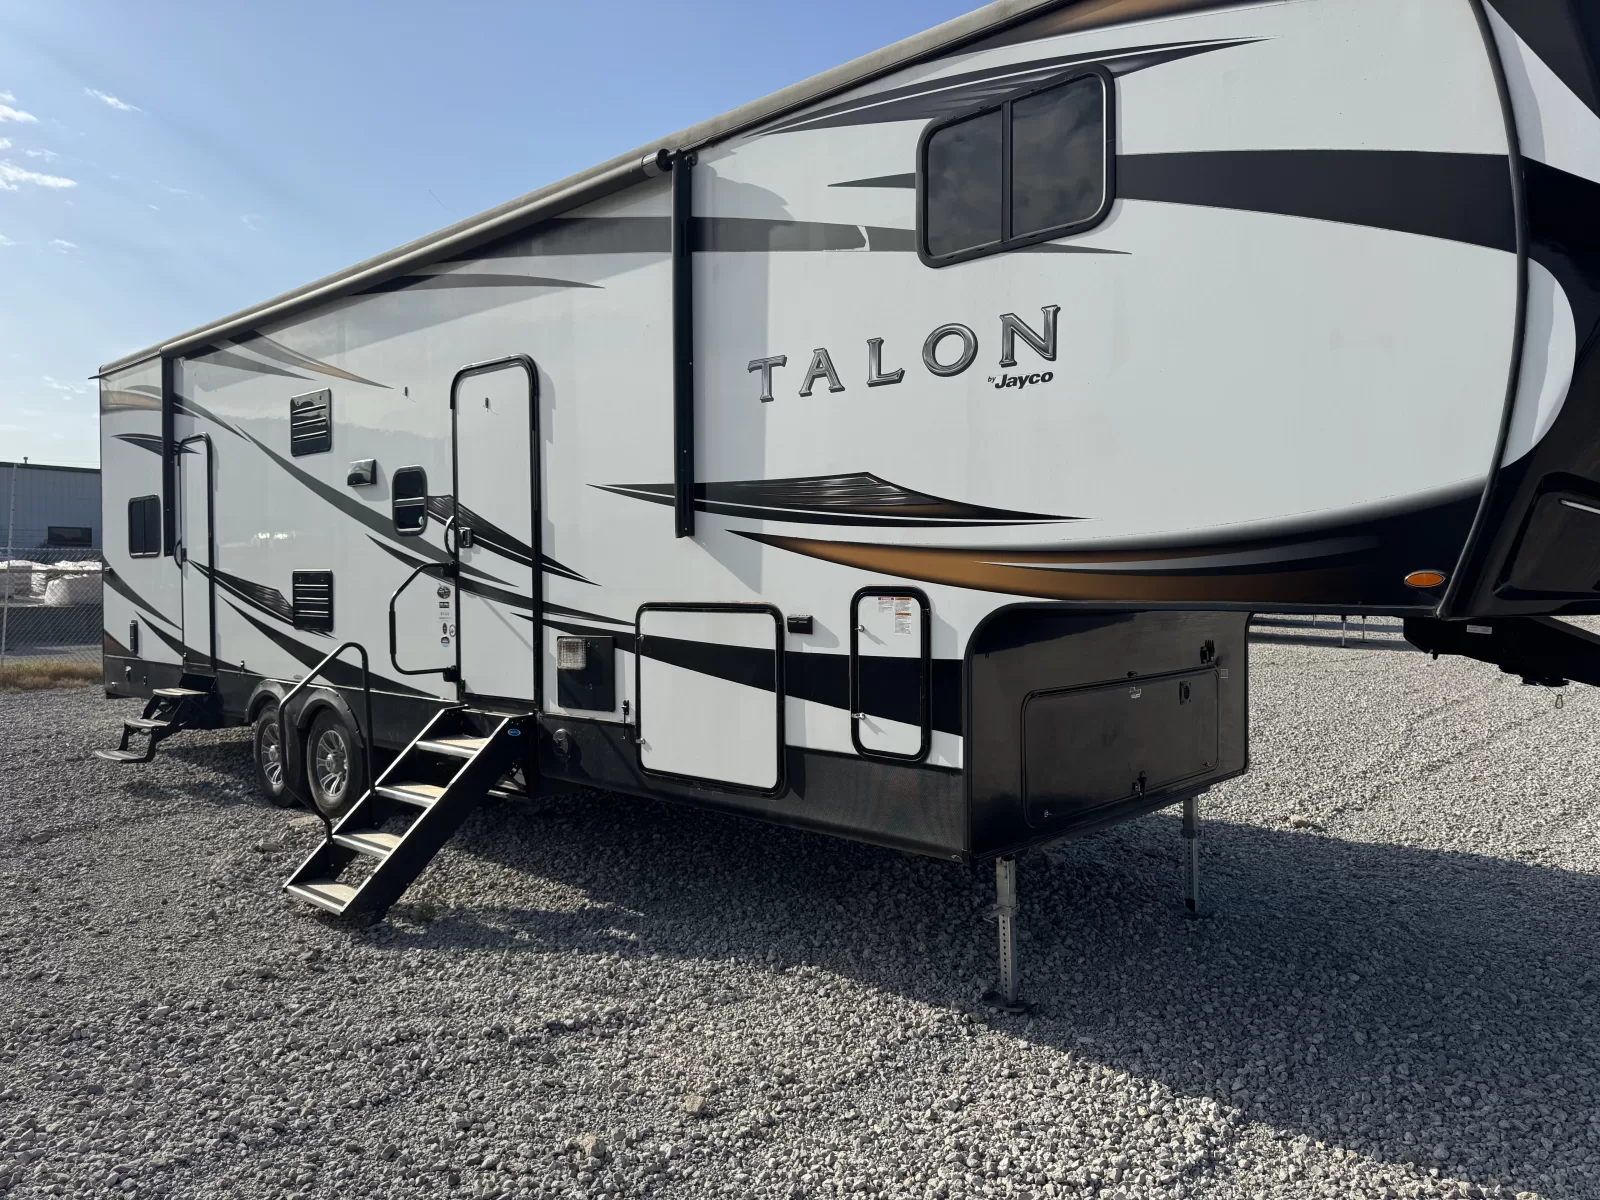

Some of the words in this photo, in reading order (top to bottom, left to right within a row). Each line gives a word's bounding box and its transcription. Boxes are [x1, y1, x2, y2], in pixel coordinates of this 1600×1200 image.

[748, 304, 1061, 402] TALON
[987, 375, 996, 384] by
[995, 371, 1054, 389] Jayco
